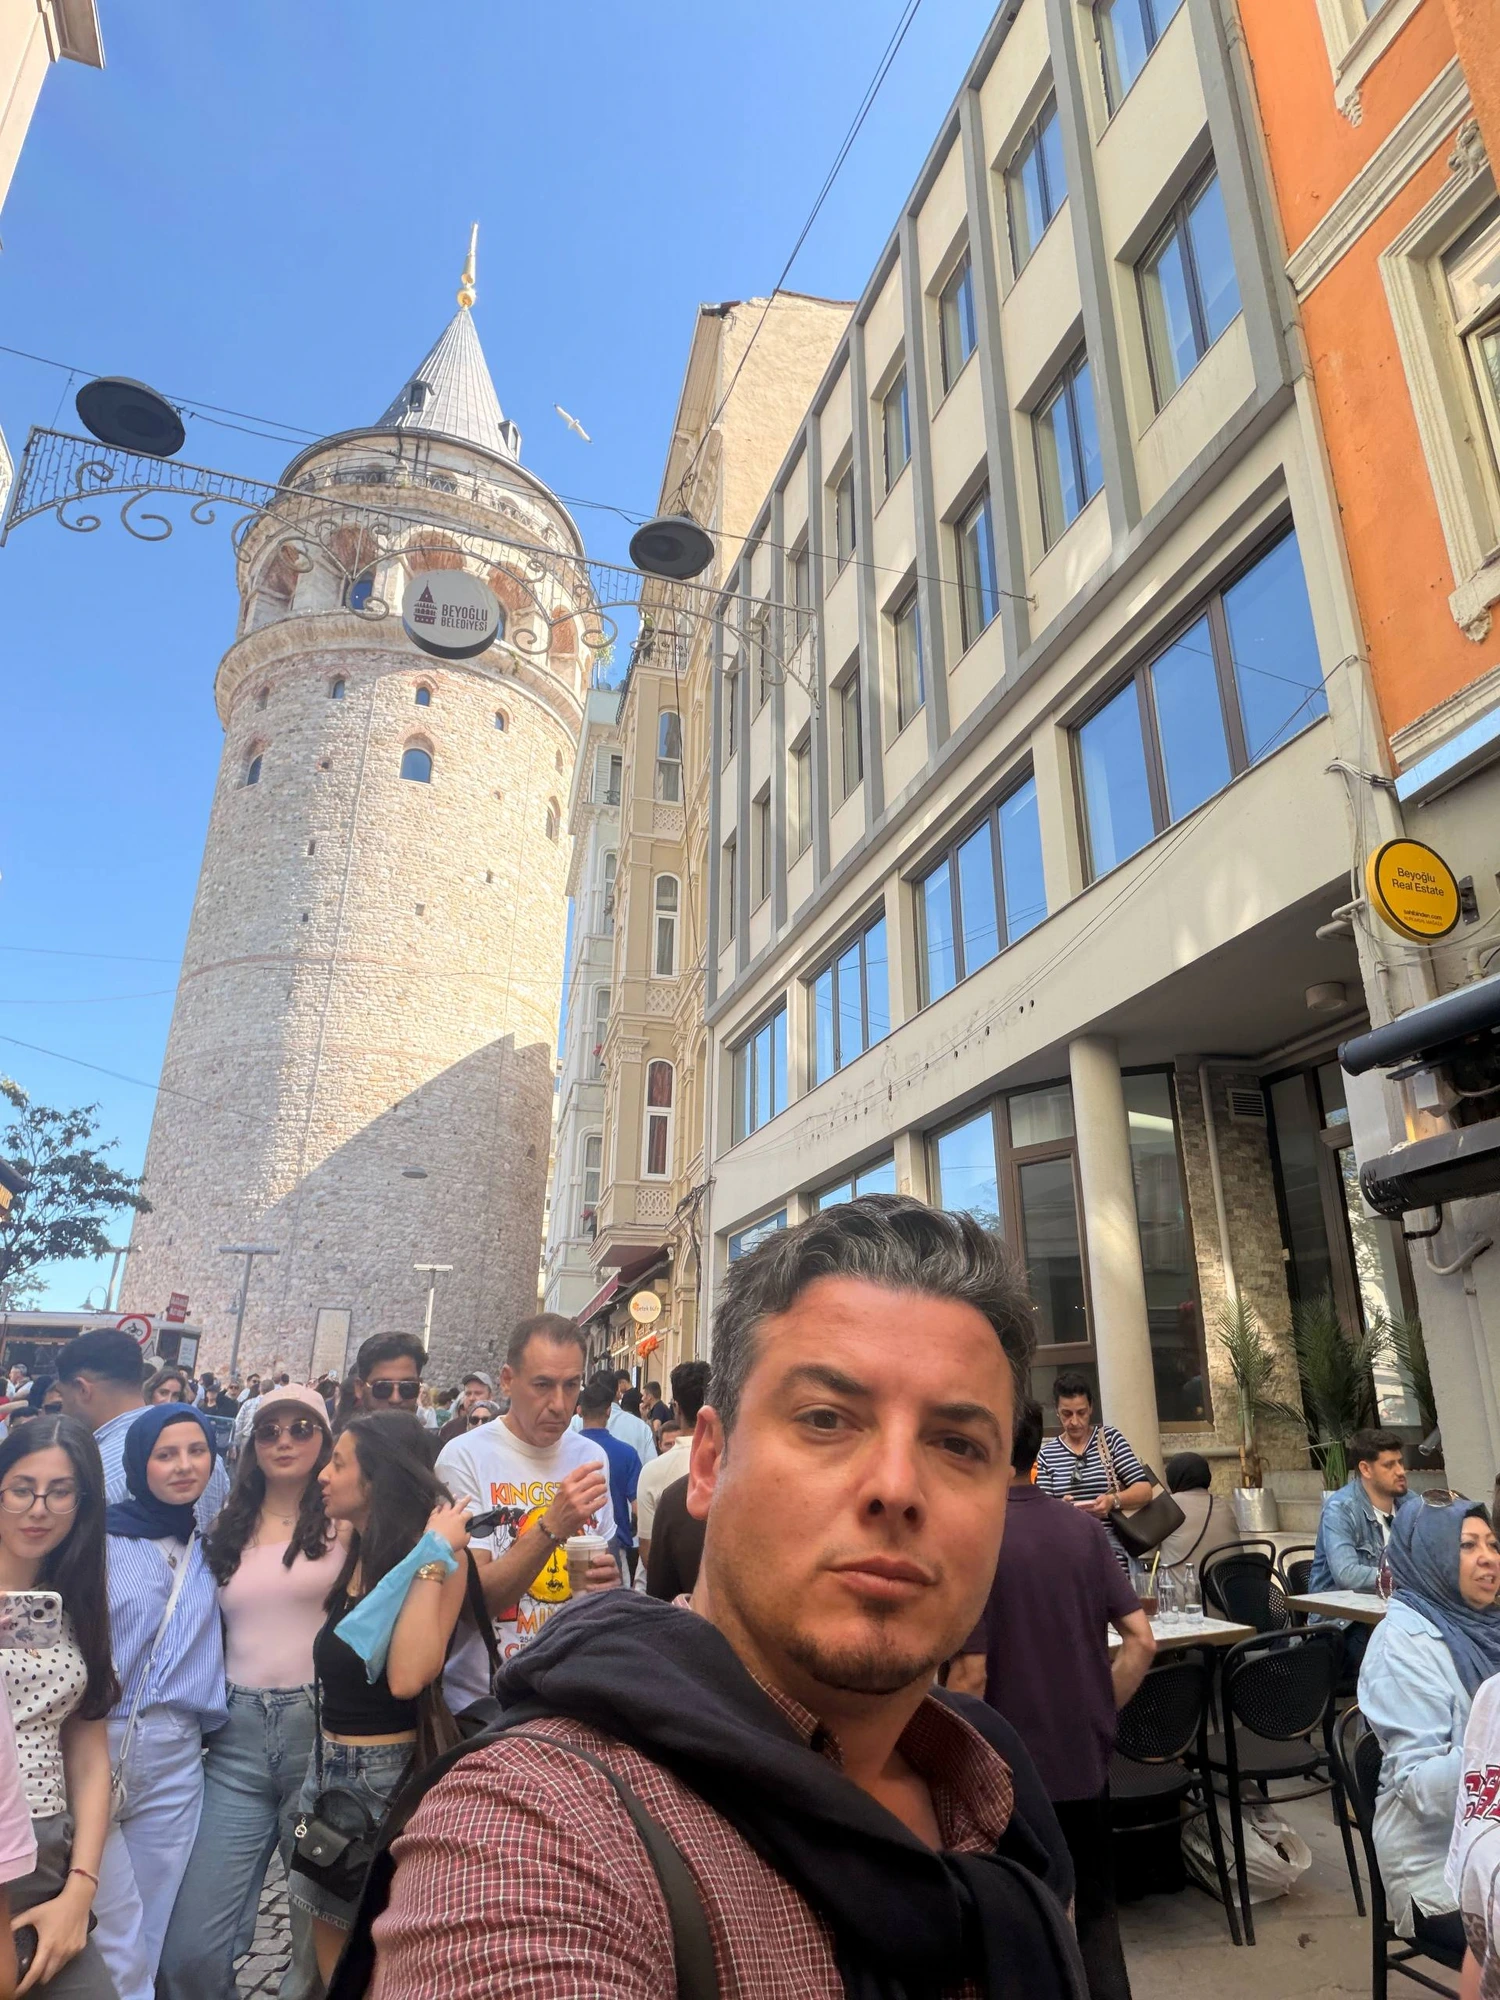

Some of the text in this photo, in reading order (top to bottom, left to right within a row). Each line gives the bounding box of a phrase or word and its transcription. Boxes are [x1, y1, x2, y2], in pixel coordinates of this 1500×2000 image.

[441, 604, 488, 621] BEYOĞLU
[1397, 867, 1436, 883] Beyoğlu
[1391, 878, 1444, 896] Real Estate
